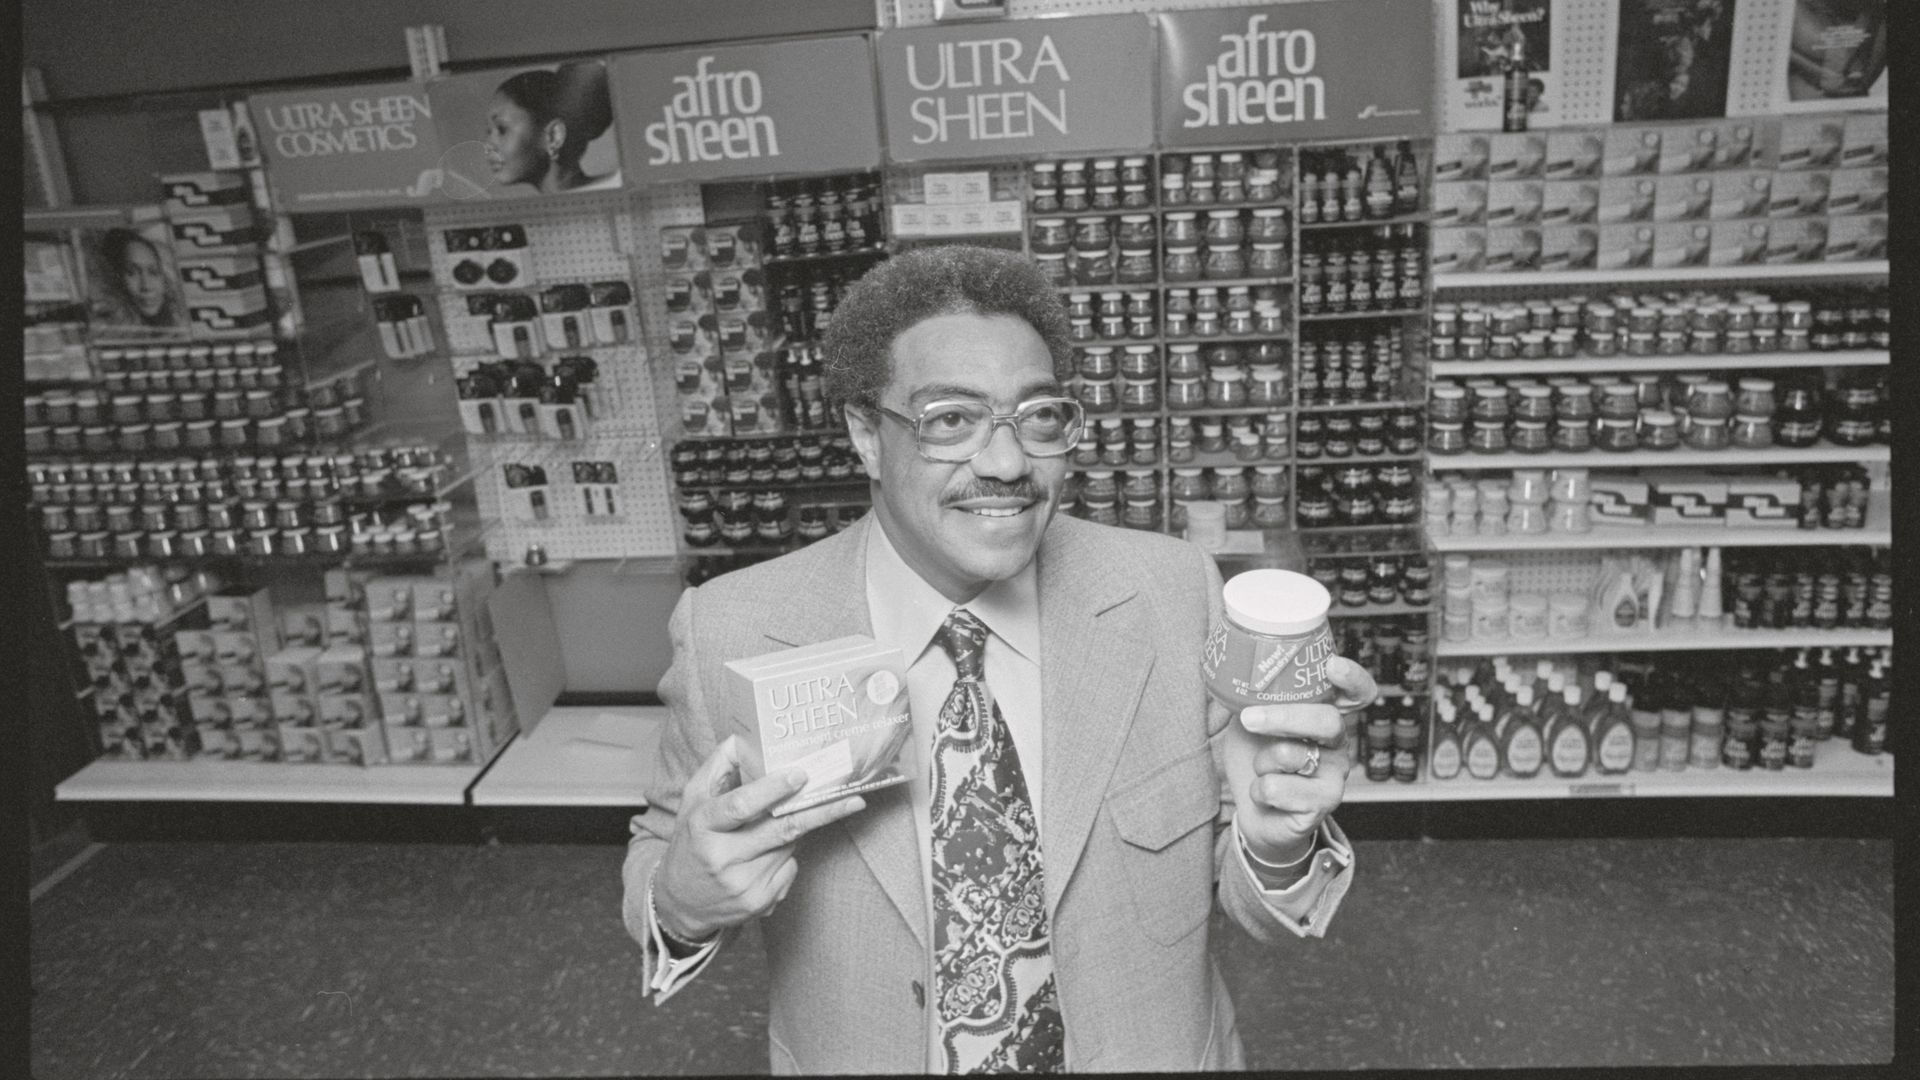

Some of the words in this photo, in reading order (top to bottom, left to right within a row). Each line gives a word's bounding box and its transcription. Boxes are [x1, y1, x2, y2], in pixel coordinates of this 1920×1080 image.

[906, 34, 1071, 91] ULTRA
[1217, 14, 1316, 79] afro
[673, 56, 762, 118] afro
[1183, 64, 1325, 128] sheen
[265, 101, 349, 132] ULTRA
[350, 93, 432, 126] SHEEN
[910, 88, 1068, 144] SHEEN
[276, 123, 417, 158] COSMETICS
[645, 105, 779, 166] sheen
[770, 672, 855, 711] ULTRA
[1256, 690, 1314, 702] conditioner
[1316, 685, 1322, 695] &
[1294, 658, 1330, 688] SHE
[774, 697, 859, 739] SHEEN
[872, 712, 909, 729] relaxer
